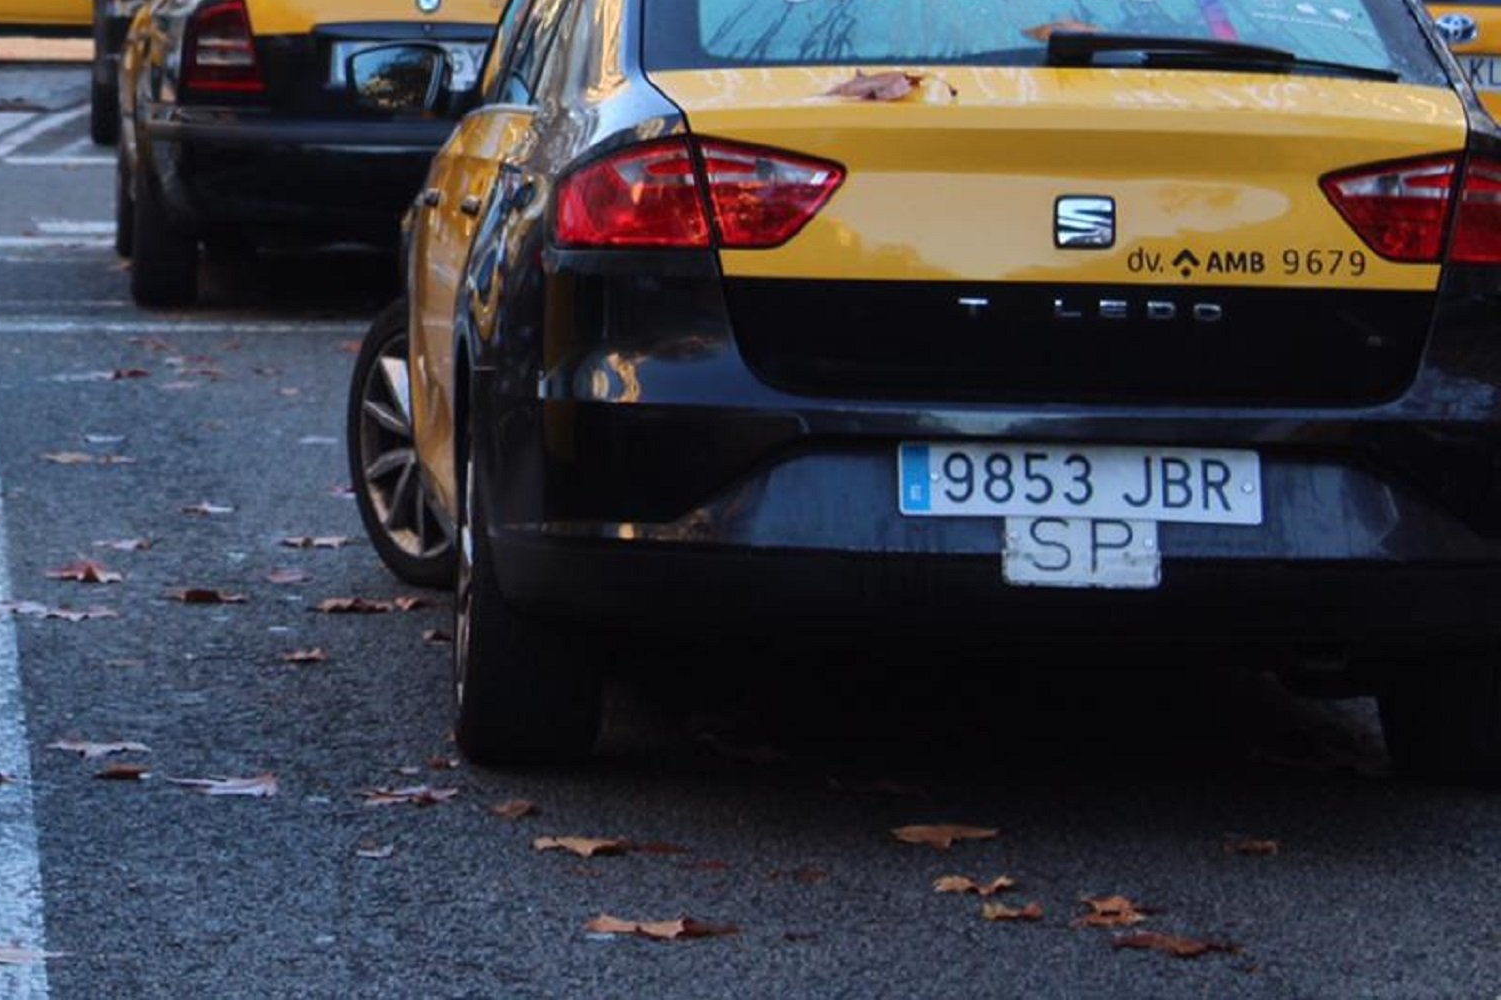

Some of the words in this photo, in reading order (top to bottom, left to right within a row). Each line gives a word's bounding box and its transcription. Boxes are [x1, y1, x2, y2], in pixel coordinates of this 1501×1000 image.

[1127, 249, 1165, 273] dv.
[1206, 252, 1266, 273] AMB
[1282, 250, 1367, 276] 9679
[957, 298, 1223, 319] TLEDO
[943, 452, 1094, 506] 9853
[1121, 457, 1232, 512] JBR
[1028, 516, 1134, 574] SP
